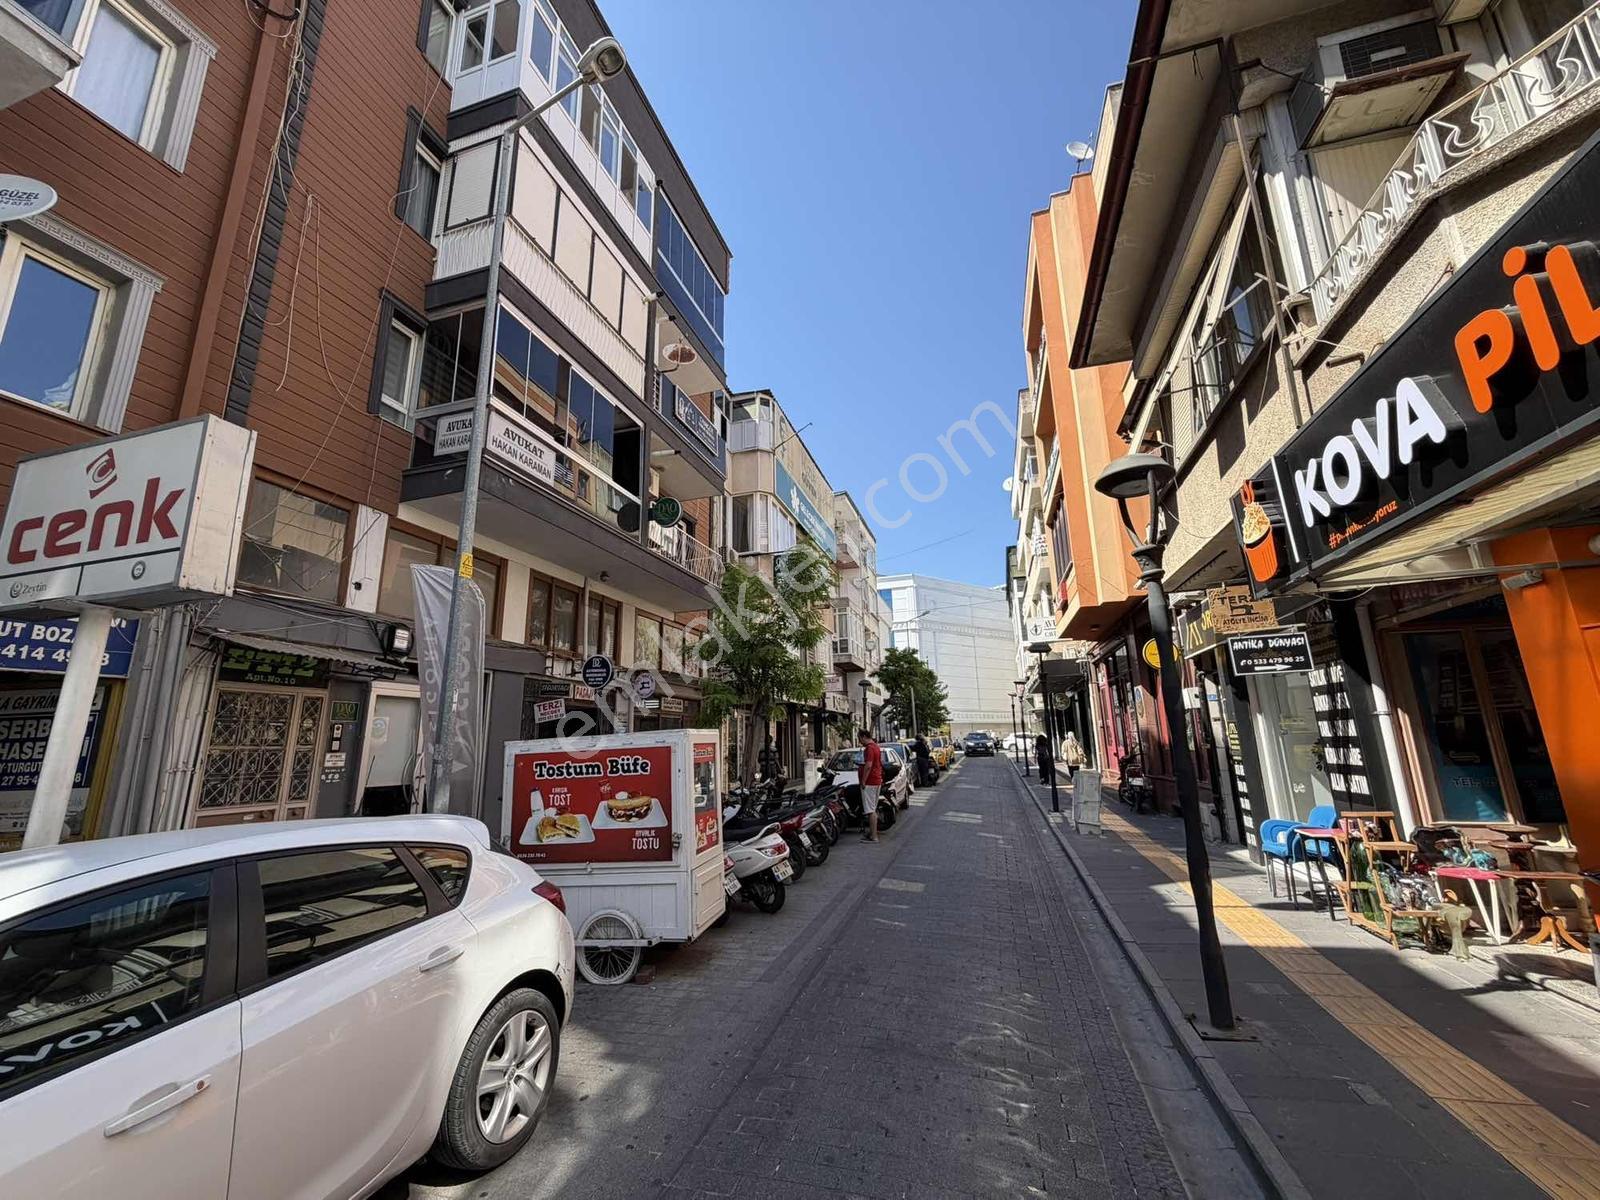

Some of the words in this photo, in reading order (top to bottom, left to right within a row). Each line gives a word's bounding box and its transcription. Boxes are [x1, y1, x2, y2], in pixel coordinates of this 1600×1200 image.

[446, 418, 472, 433] AVUKA
[439, 435, 456, 449] HAKAN
[456, 434, 472, 446] KARA
[503, 427, 545, 460] AVUKAT
[1294, 377, 1447, 528] KOVA
[491, 435, 518, 460] HAKAN
[518, 451, 552, 480] KARAMAN
[7, 477, 186, 565] cenk
[31, 624, 76, 643] BOZ
[534, 760, 603, 780] Tostum
[607, 755, 651, 776] Büfe
[549, 793, 572, 806] TOST
[632, 837, 660, 850] TOSTU
